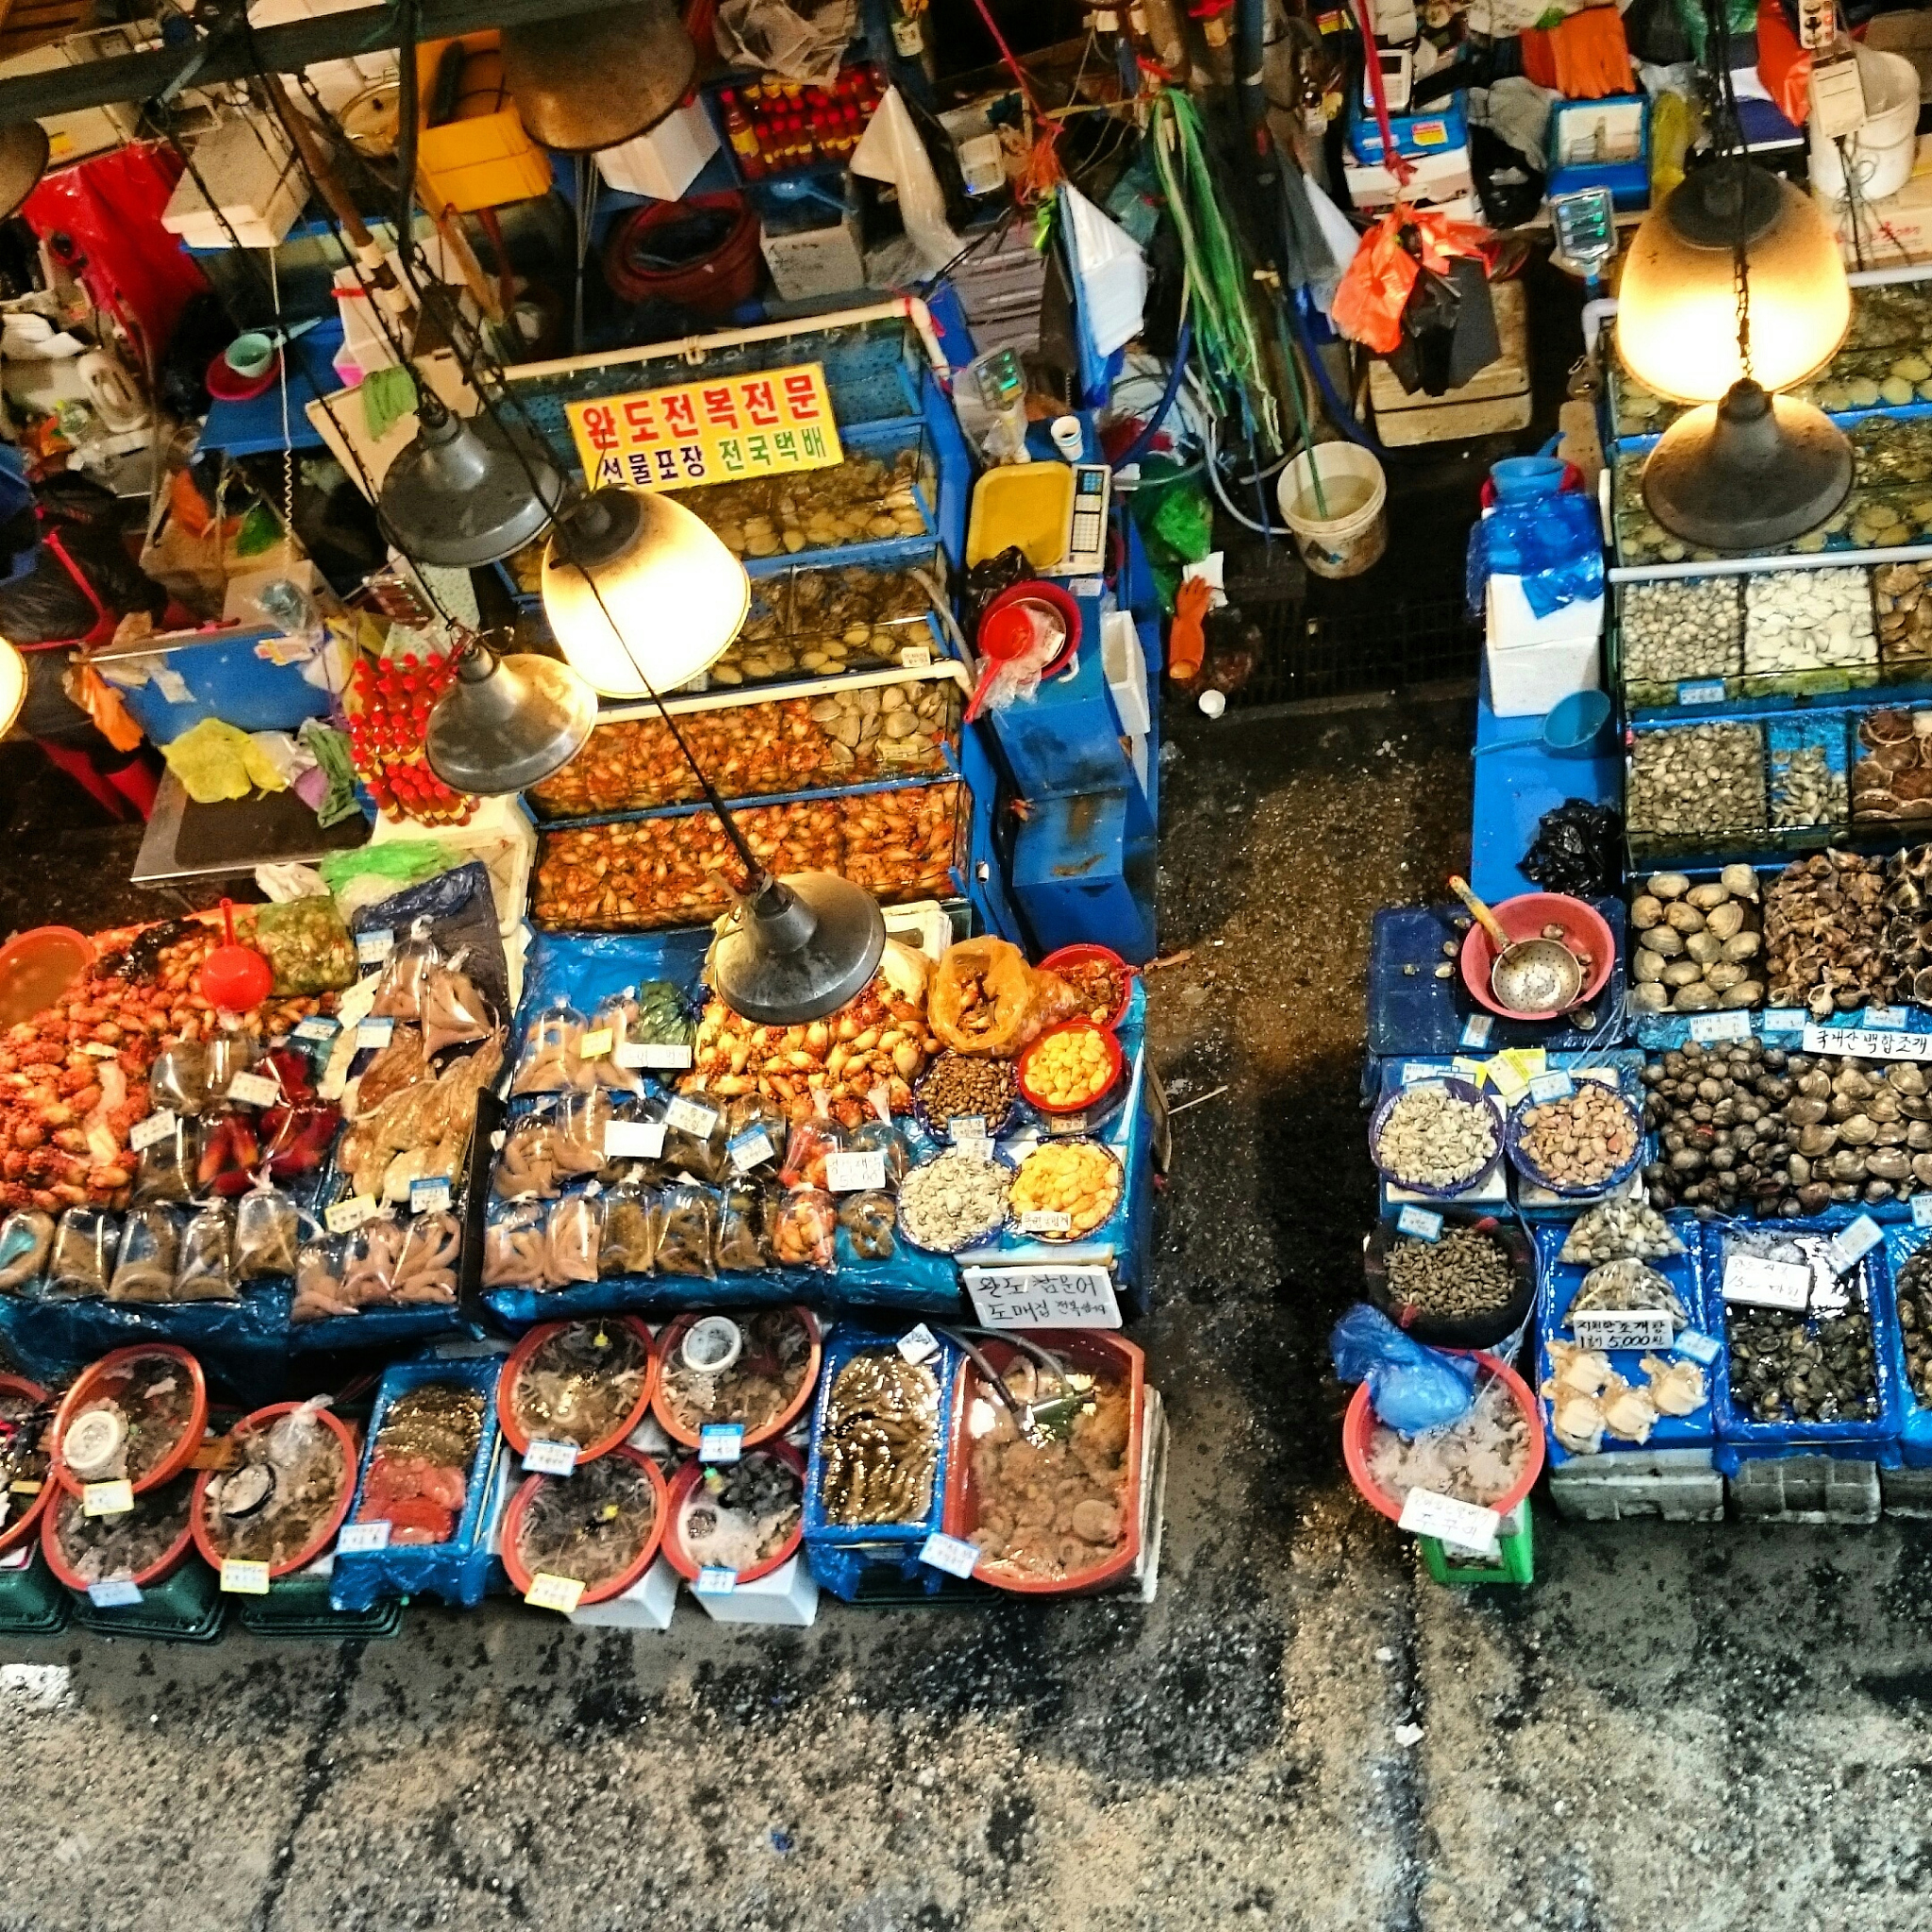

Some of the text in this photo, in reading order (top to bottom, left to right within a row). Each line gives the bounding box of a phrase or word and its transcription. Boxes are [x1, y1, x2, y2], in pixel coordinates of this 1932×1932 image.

[582, 374, 819, 450] 완도전복전문
[719, 425, 825, 472] 전국택배
[977, 1274, 1097, 1298] 완도 참문어
[988, 1299, 1050, 1322] 도매집
